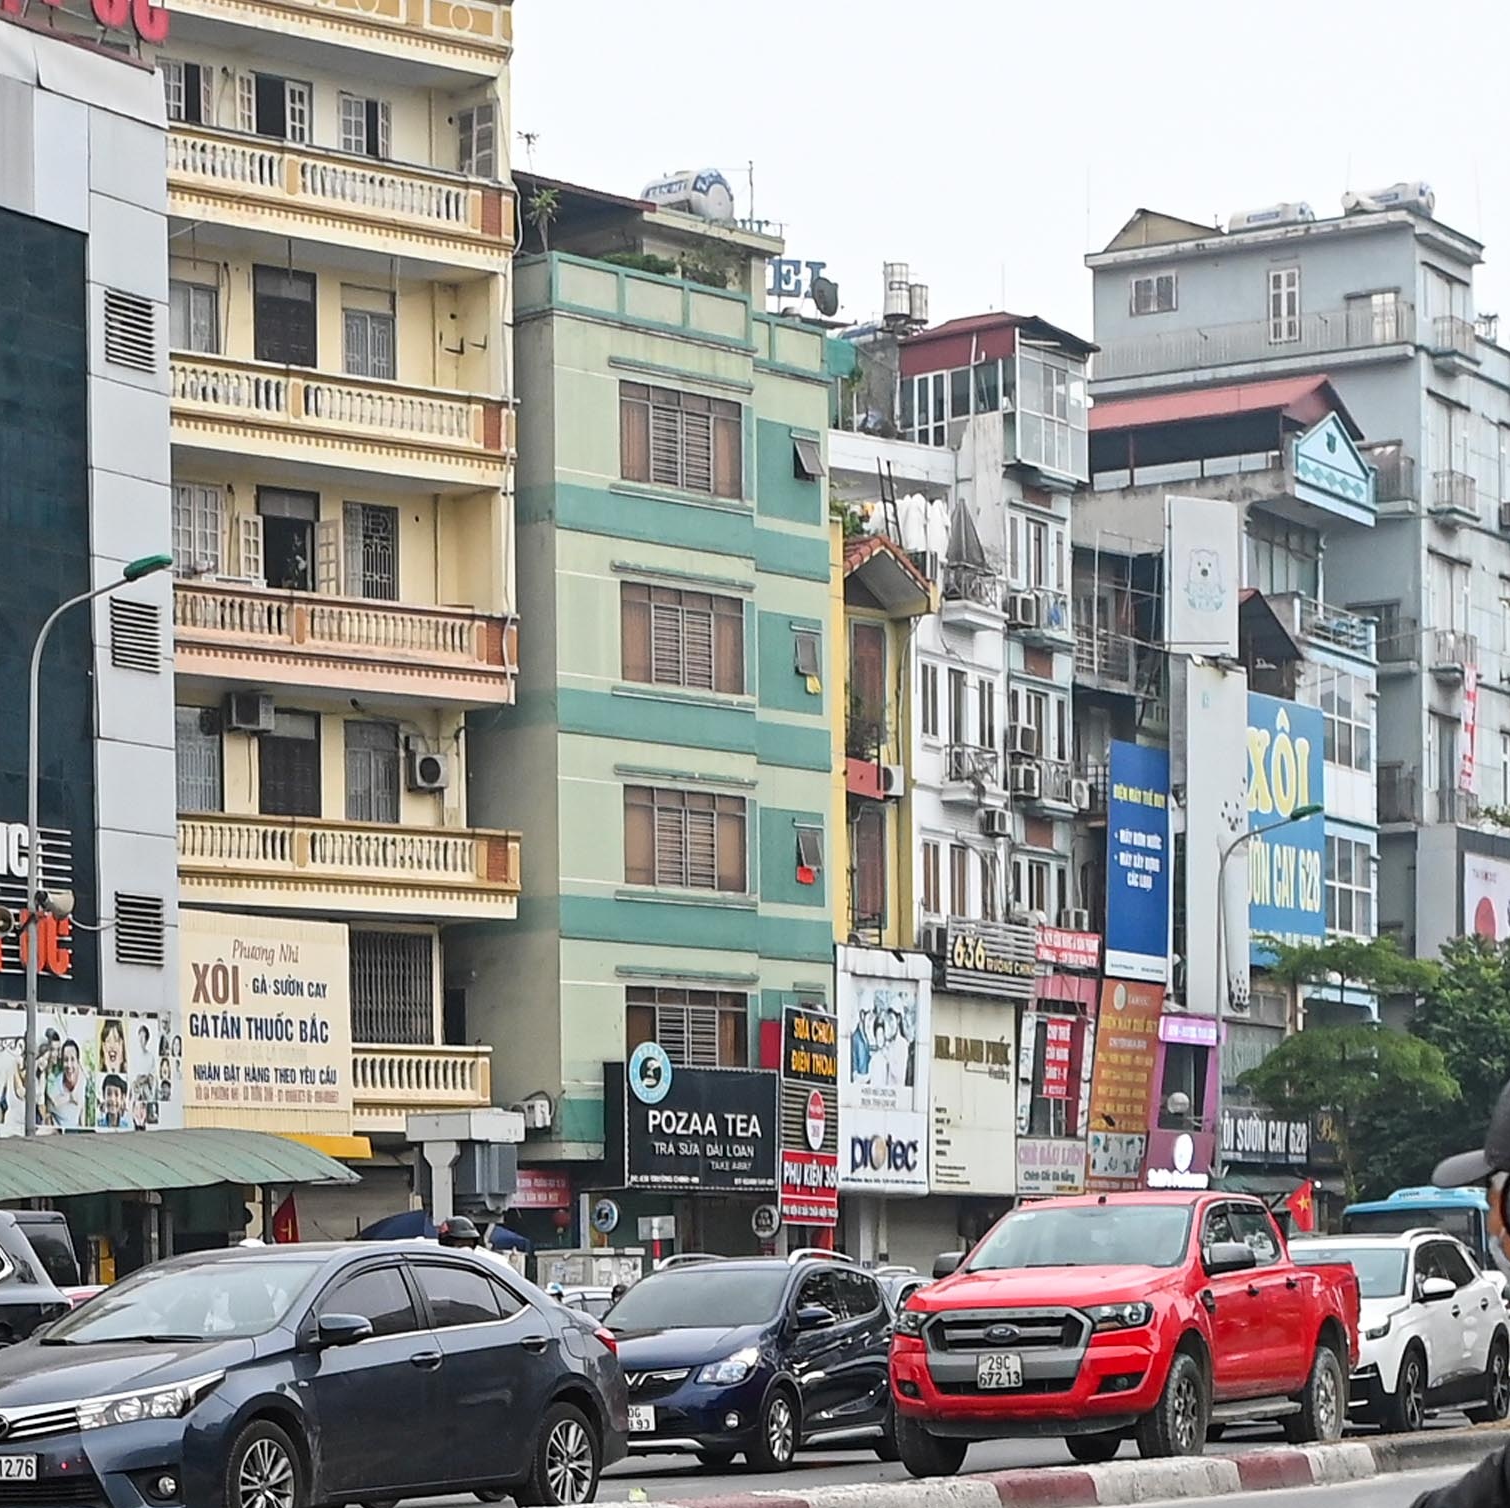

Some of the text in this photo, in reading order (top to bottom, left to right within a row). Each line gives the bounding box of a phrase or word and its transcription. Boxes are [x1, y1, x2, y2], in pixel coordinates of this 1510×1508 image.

[1247, 706, 1310, 820] XÔI
[1274, 843, 1297, 909] CAY
[1299, 849, 1321, 913] 628
[232, 939, 275, 966] Phương
[954, 934, 986, 971] 636
[192, 958, 240, 1005] XÔI
[308, 982, 327, 998] CAY
[246, 1012, 293, 1042] THUỐC
[299, 1013, 329, 1044] BẮC
[193, 1062, 220, 1084] NHẬN
[245, 1063, 270, 1084] HÀNG
[274, 1067, 296, 1085] THEO
[648, 1109, 762, 1138] POZAA TEA
[1220, 1110, 1234, 1149] ÔI
[1237, 1111, 1266, 1152] SƯỜN
[1268, 1119, 1288, 1153] CAY
[1289, 1121, 1307, 1154] 628
[727, 1143, 754, 1158] LOAN
[784, 1161, 802, 1193] PHỤ
[804, 1158, 823, 1194] KIỆN
[988, 1356, 1010, 1371] 29C
